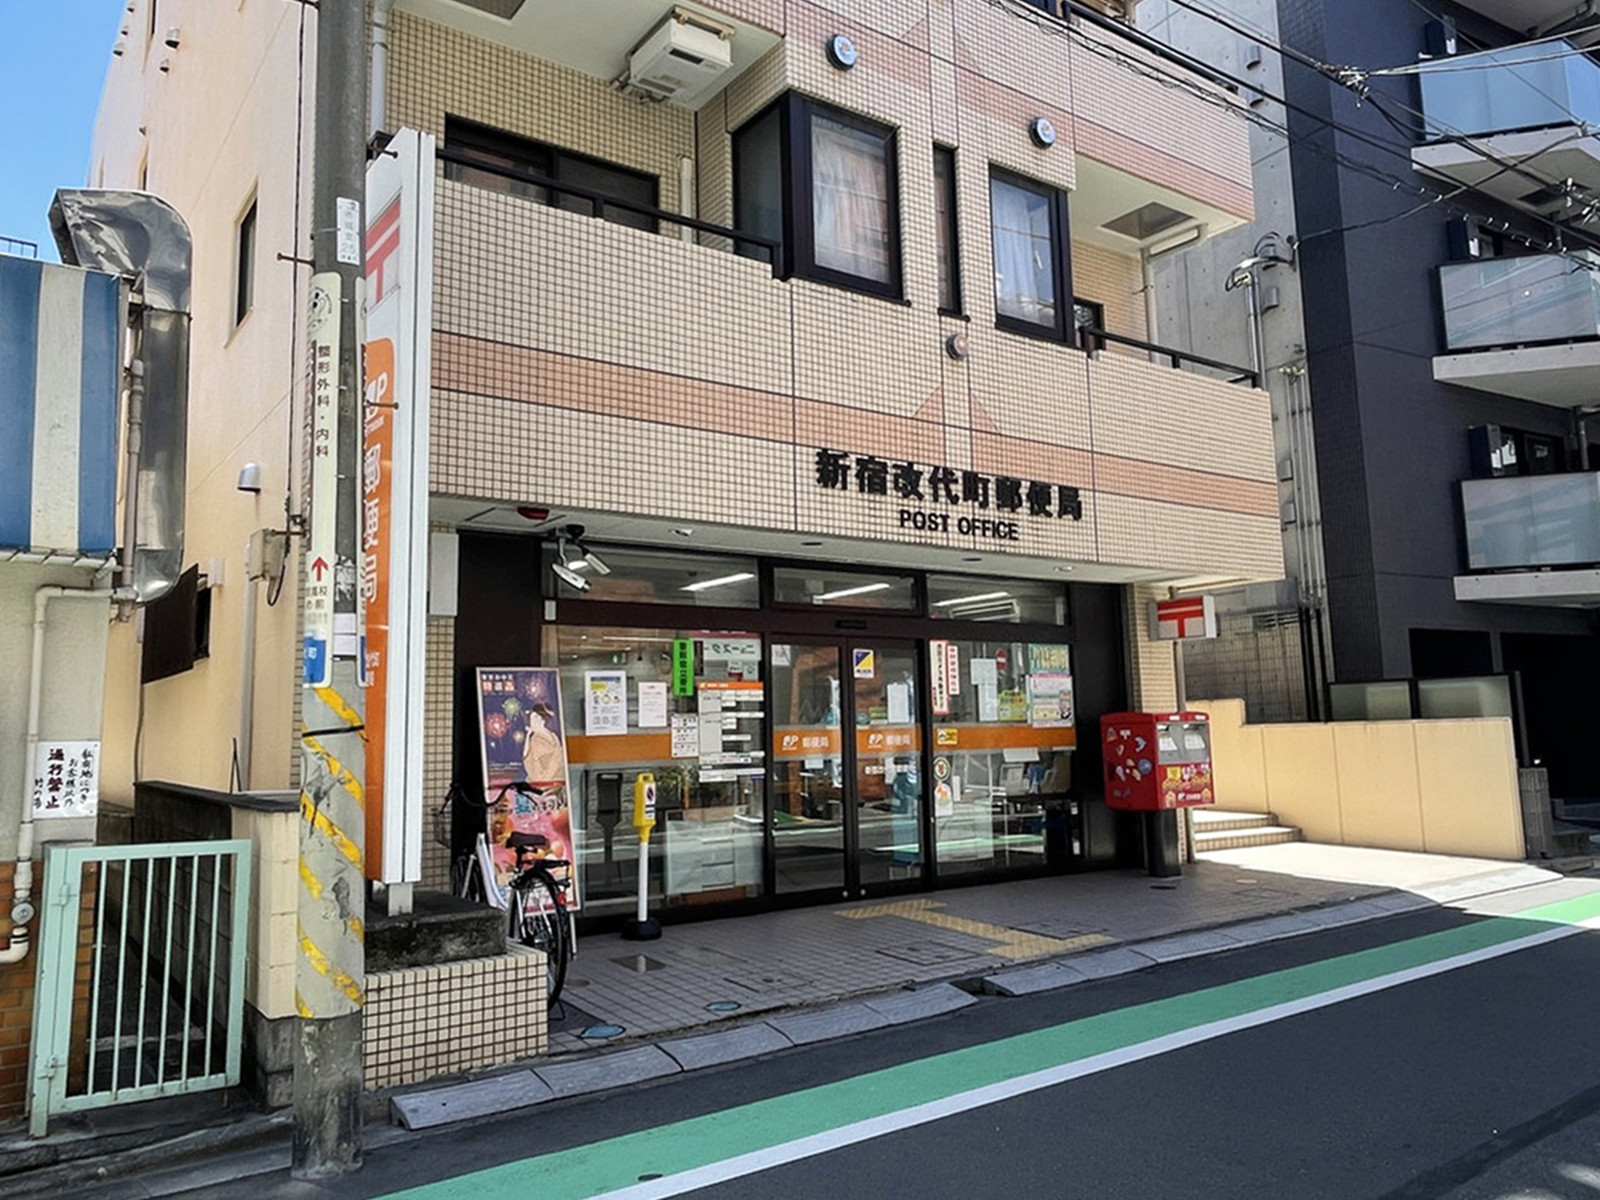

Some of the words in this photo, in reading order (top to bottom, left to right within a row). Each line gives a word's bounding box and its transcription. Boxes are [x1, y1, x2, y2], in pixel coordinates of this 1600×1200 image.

[316, 345, 331, 457] 整形外科・内科
[815, 449, 1082, 521] 新宿改代町郵便局
[899, 508, 950, 532] POST
[957, 516, 1019, 541] OFFICE
[45, 748, 64, 809] 通行禁止
[80, 748, 94, 804] 私有地につき
